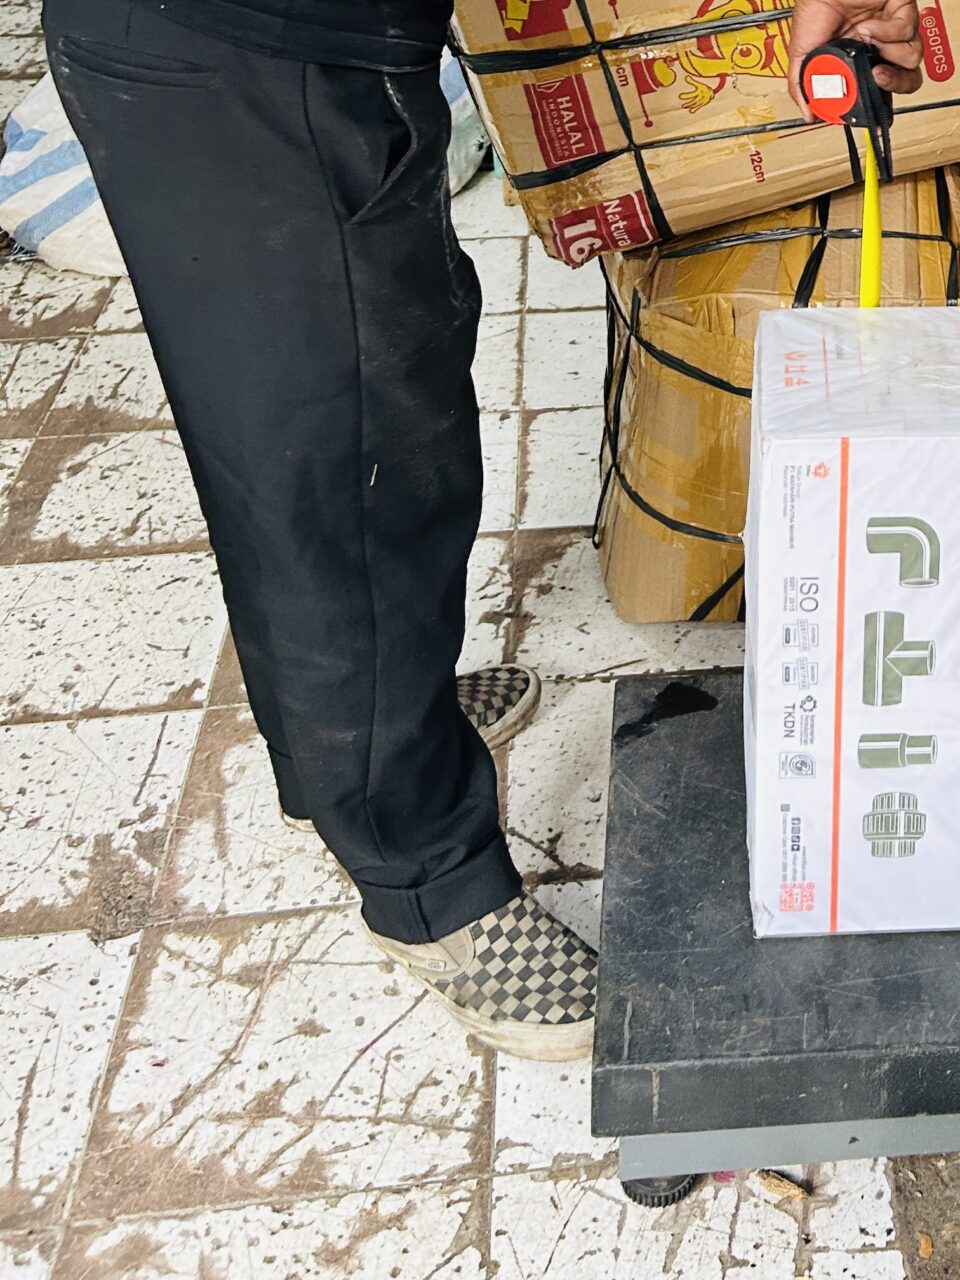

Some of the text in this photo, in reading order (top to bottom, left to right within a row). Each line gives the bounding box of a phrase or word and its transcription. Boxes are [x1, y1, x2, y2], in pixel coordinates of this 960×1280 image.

[922, 14, 949, 74] @50PCS
[615, 63, 630, 88] cm
[547, 97, 570, 158] INDONESIA
[556, 95, 586, 155] HALAL
[750, 149, 766, 184] 12cm
[602, 198, 631, 248] Natura
[800, 576, 819, 613] ISO
[783, 702, 796, 739] TKDN
